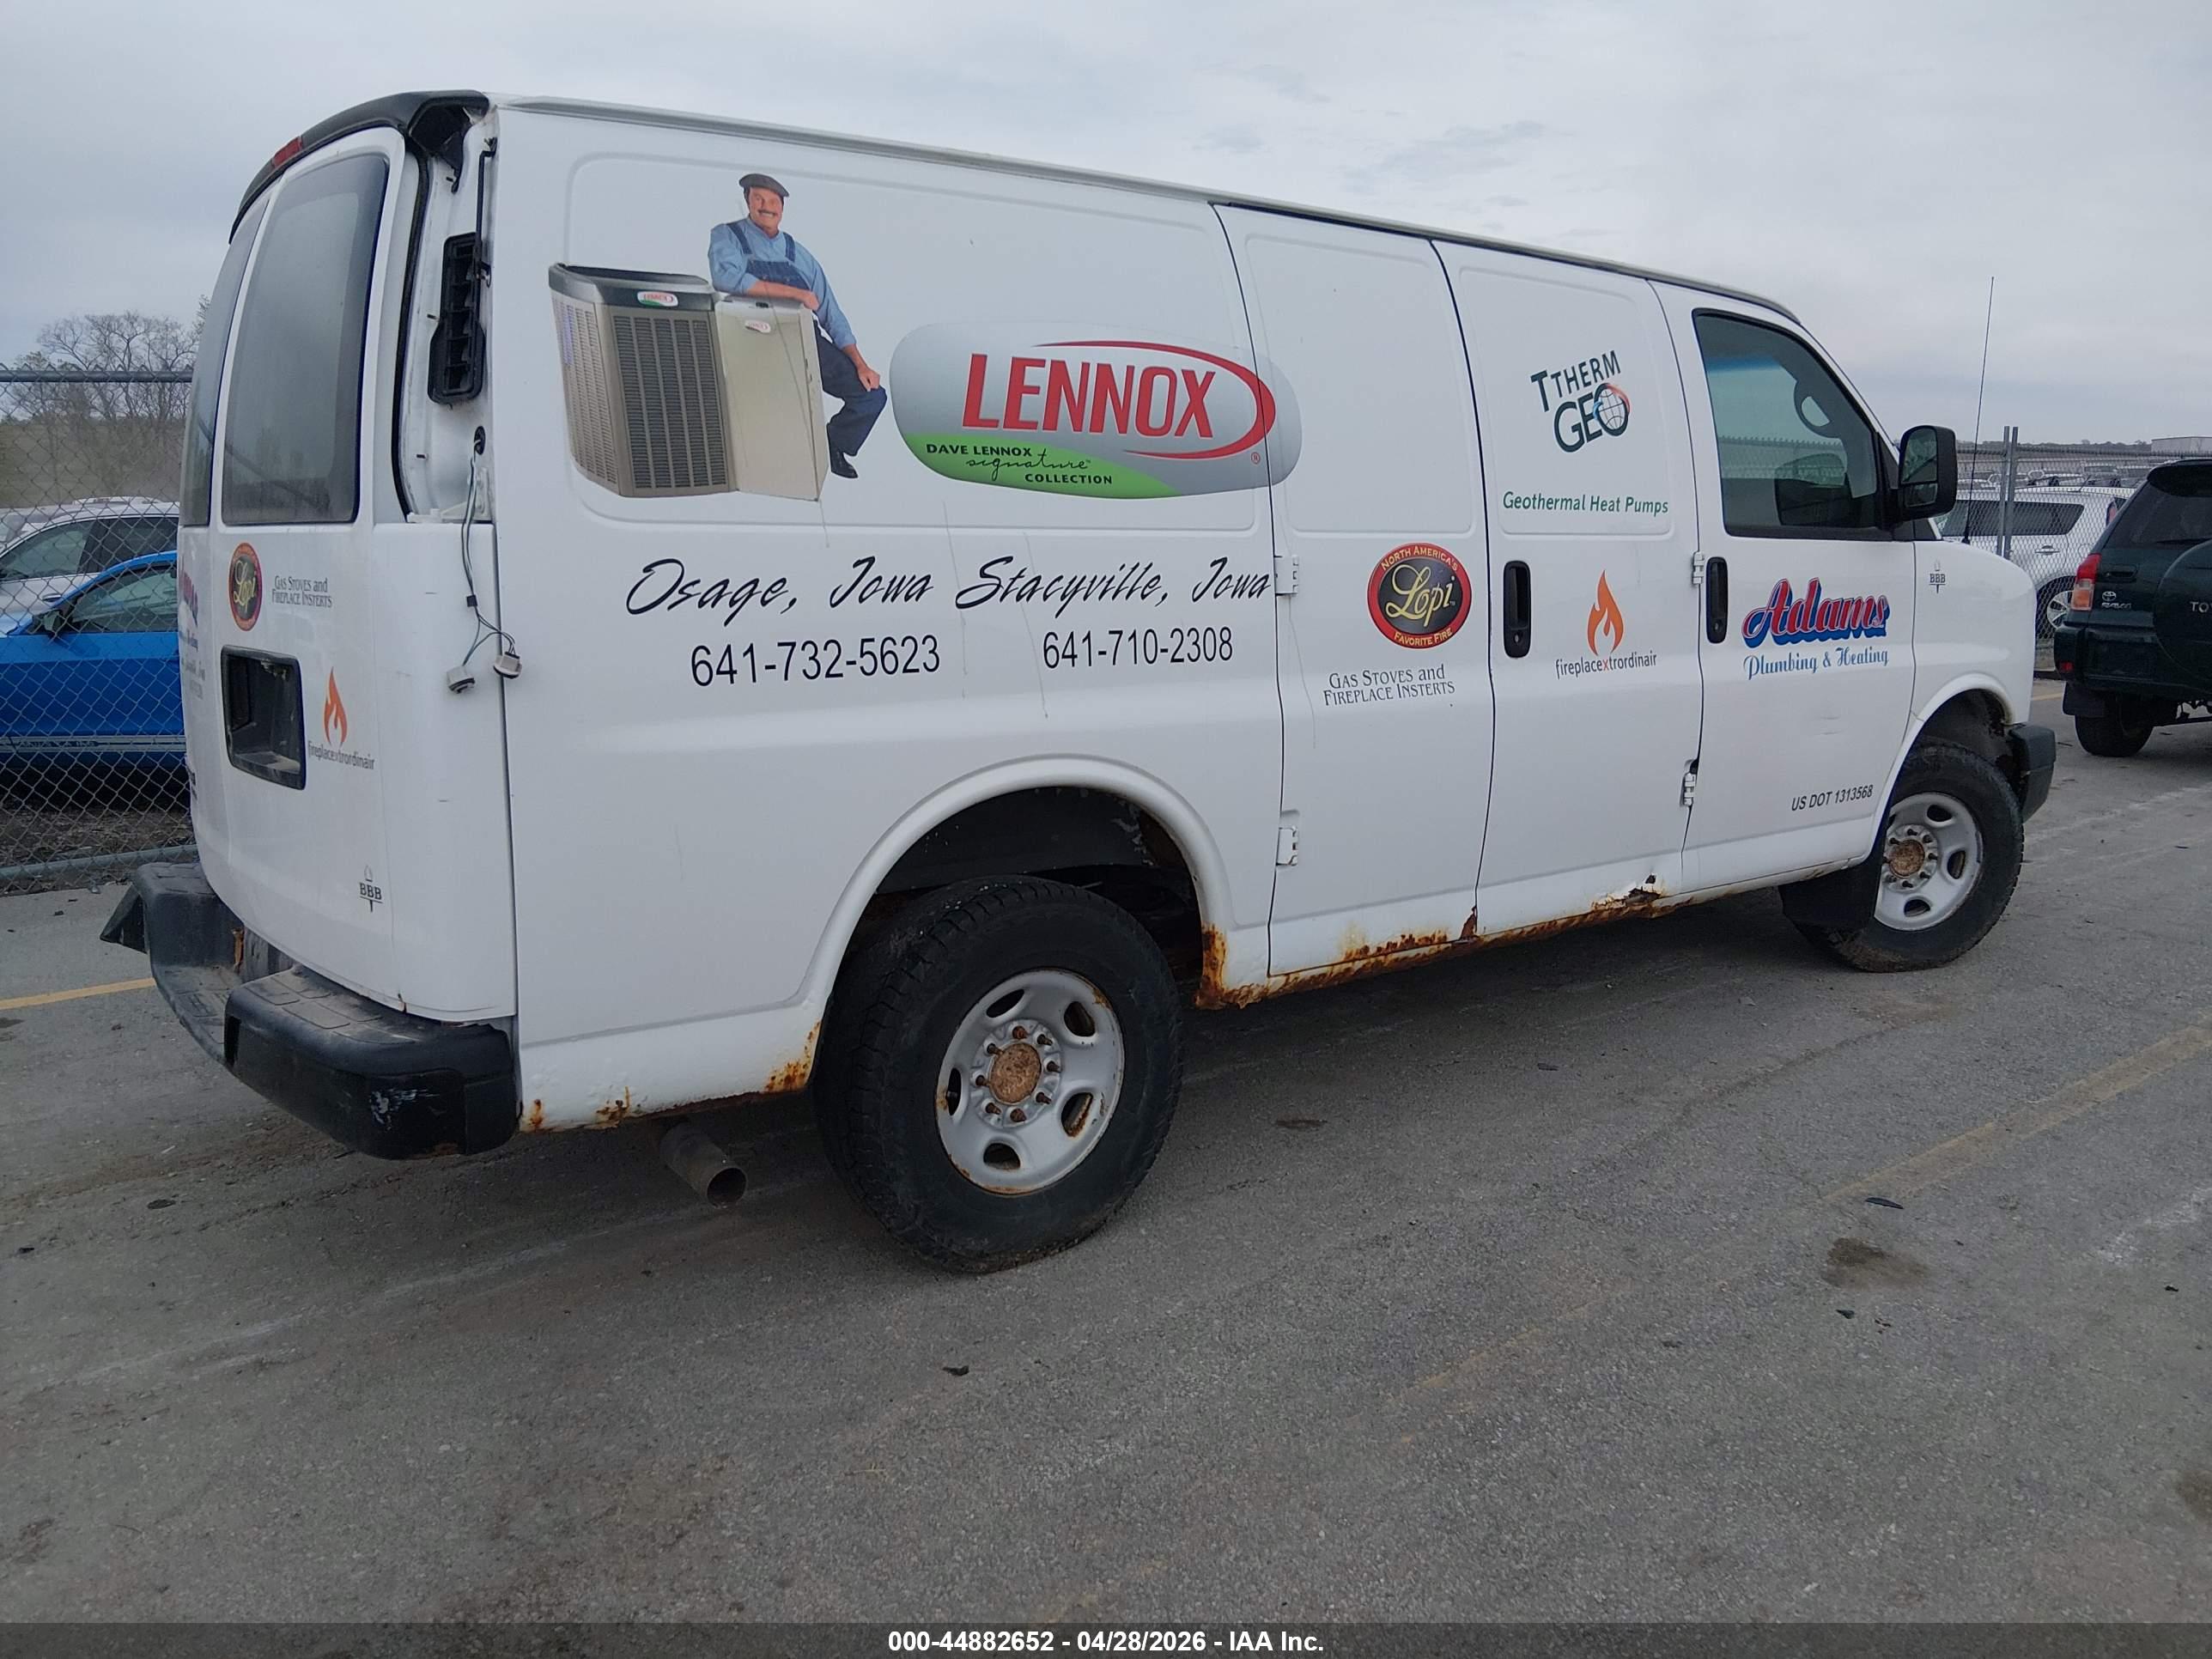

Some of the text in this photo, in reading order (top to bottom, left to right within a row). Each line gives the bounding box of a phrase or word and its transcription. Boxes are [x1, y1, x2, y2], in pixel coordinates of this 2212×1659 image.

[962, 353, 1216, 438] LENNOX
[1553, 382, 1630, 453] GEO
[927, 444, 1031, 457] DAVE LENNOX
[966, 448, 1088, 481] signature
[1025, 473, 1112, 484] COLLECTION
[1503, 491, 1668, 517] Geothermal Heat Pumps
[1380, 545, 1458, 571] NORTH AMERICA'S
[627, 556, 1272, 627] Osage, Iowa Stacyville, Iowa
[1929, 574, 1946, 583] BBB
[1385, 563, 1455, 627] Lopi
[2190, 601, 2212, 613] TO
[1741, 577, 1891, 648] Adams
[1043, 627, 1233, 668] 641-710-2308
[1394, 628, 1453, 646] FAVORITE FIRE
[691, 635, 940, 687] 641-732-5623
[1555, 650, 1656, 679] fireplacextrordinair
[1743, 647, 1889, 680] Plumbing & Heating
[1329, 664, 1445, 689] GAS STOVES and
[1323, 681, 1455, 706] FIREPLACE INSTERTS
[1791, 785, 1873, 811] US DOT 1313568
[359, 882, 382, 900] BBB
